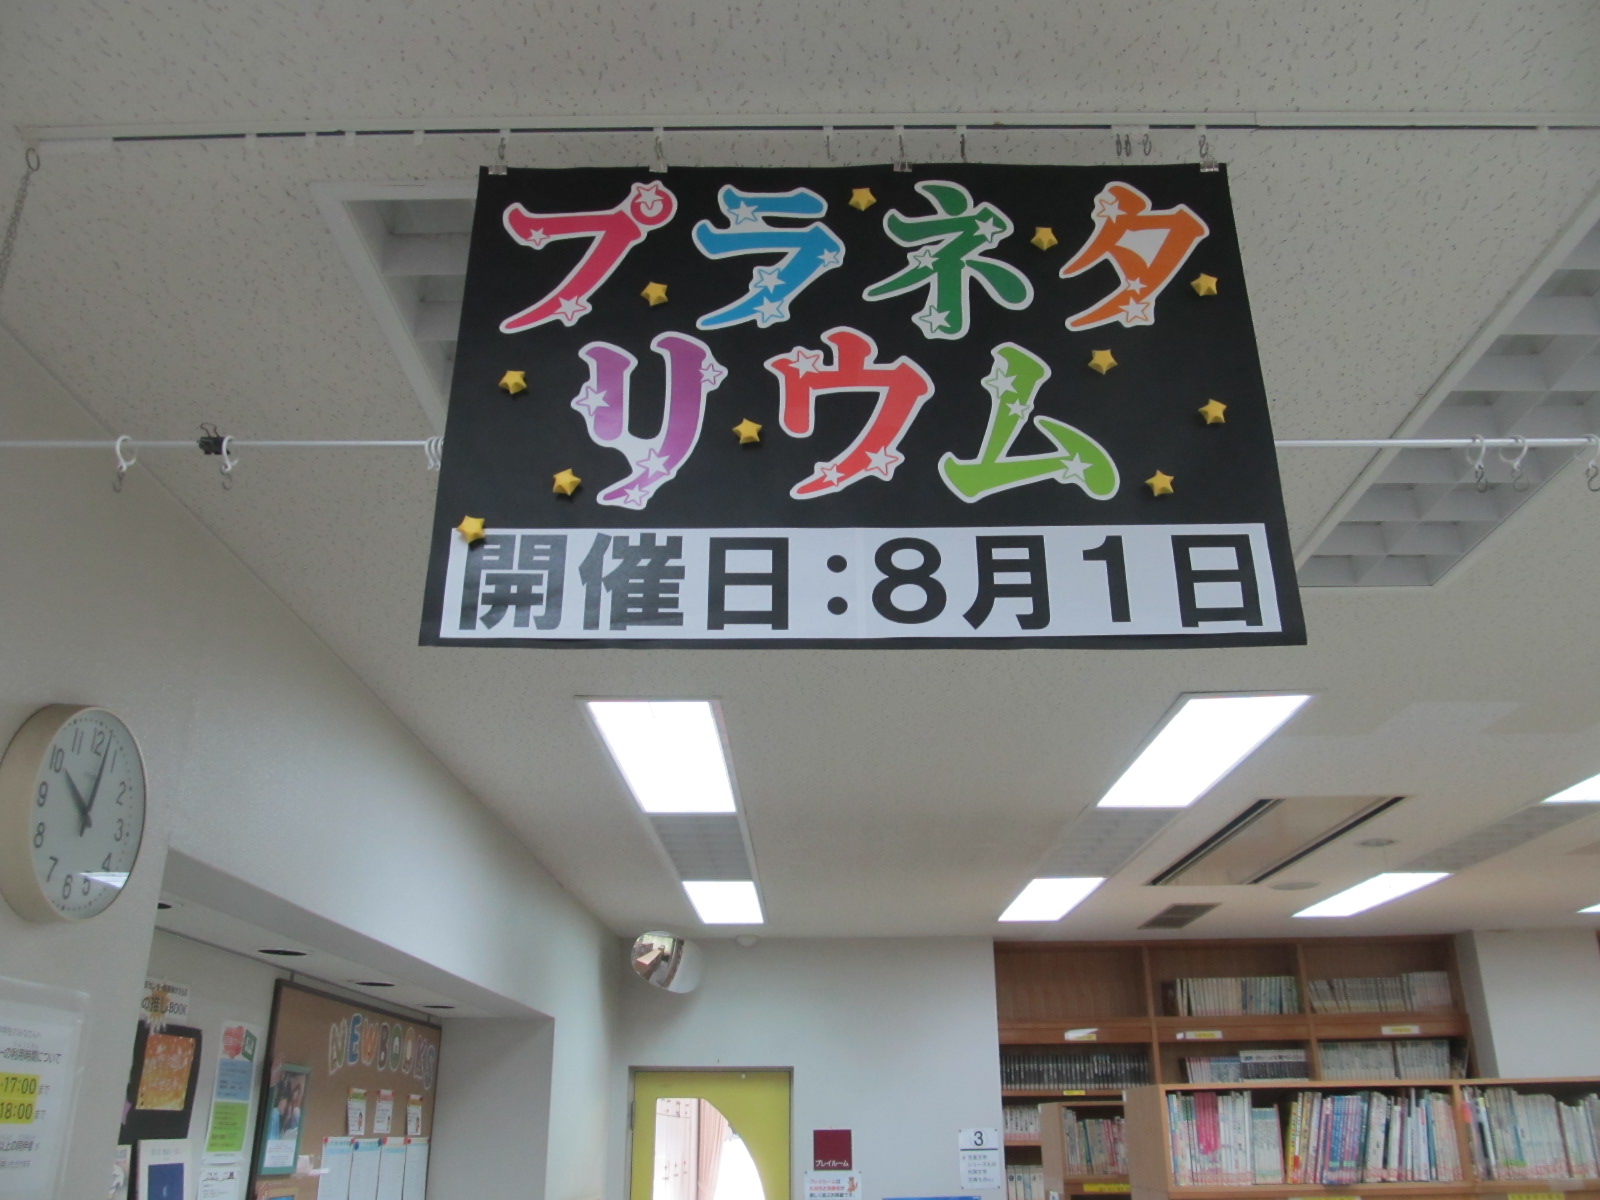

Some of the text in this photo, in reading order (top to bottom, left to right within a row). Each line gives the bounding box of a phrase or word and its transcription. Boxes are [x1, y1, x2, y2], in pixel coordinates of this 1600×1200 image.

[499, 180, 1210, 341] プラネタ
[570, 325, 1121, 510] リウム
[71, 727, 84, 756] 11
[90, 727, 105, 757] 12
[49, 745, 65, 773] 10
[36, 781, 49, 807] 9
[115, 781, 127, 805] 2
[33, 822, 45, 849] 8
[114, 818, 124, 842] 3
[46, 855, 59, 882] 7
[101, 852, 112, 872] 4
[62, 874, 73, 900] 6
[973, 1130, 984, 1147] 3
[815, 1159, 849, 1167] プレイルーム
